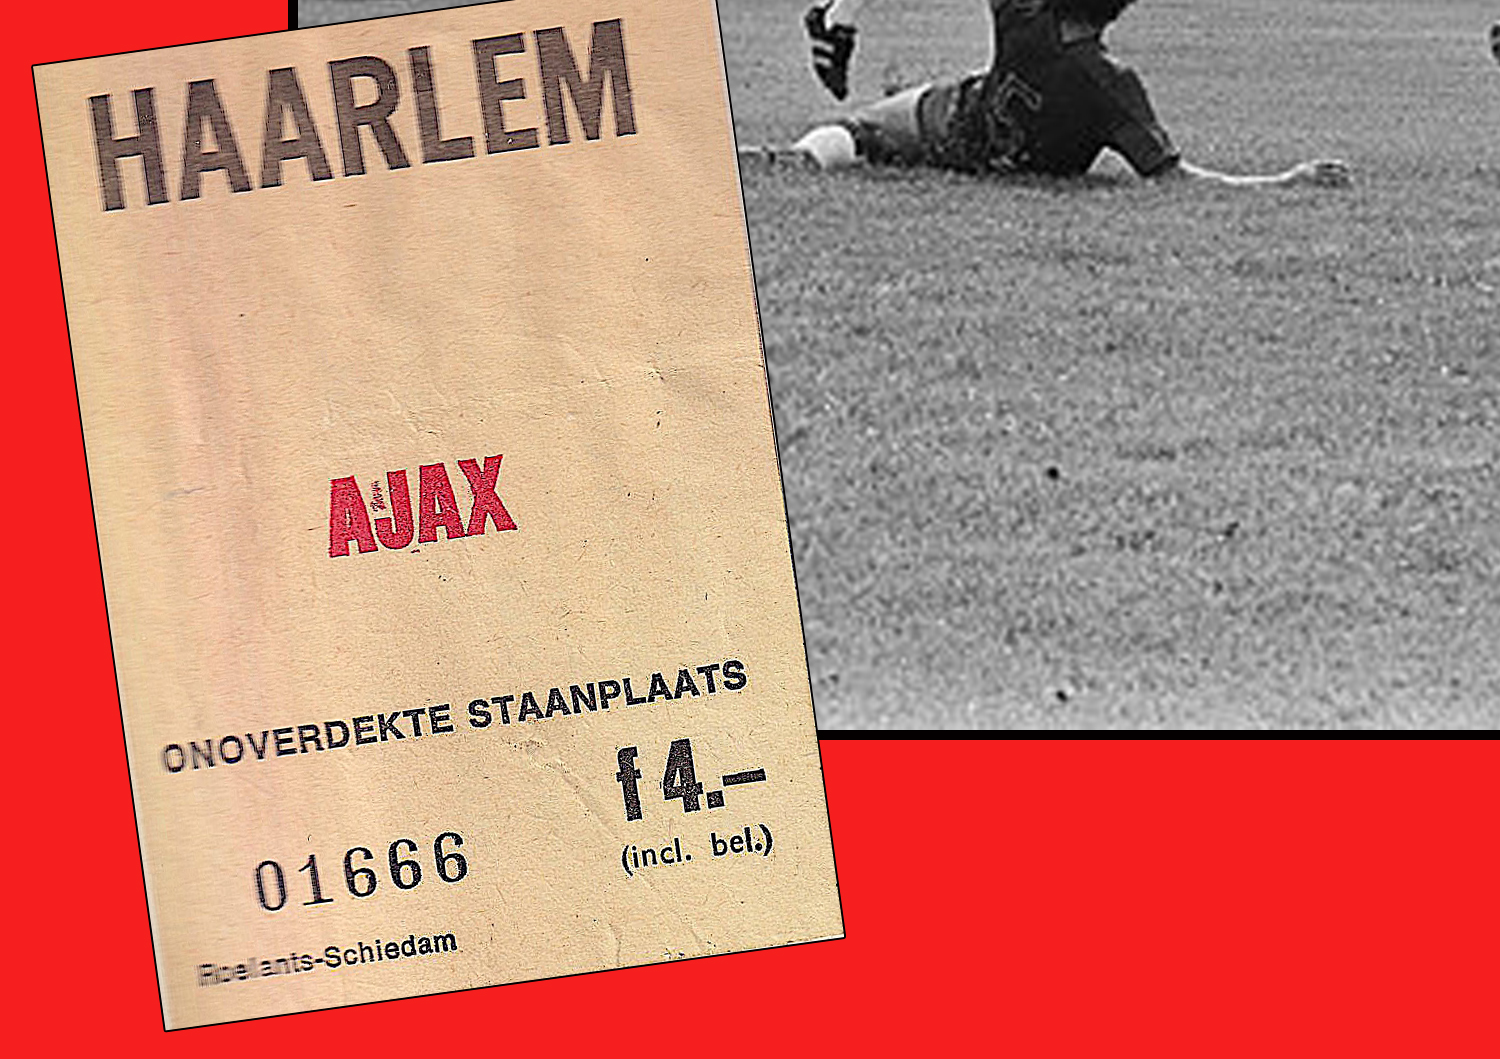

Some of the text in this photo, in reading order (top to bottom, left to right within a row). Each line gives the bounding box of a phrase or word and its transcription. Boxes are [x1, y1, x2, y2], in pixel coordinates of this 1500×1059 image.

[86, 17, 638, 213] HAARLEM
[328, 453, 518, 558] AJAX
[160, 659, 748, 774] ONOVERDEKTE STAANPLAATS
[253, 830, 471, 913] 01666
[621, 823, 774, 877] (incl. bel.)
